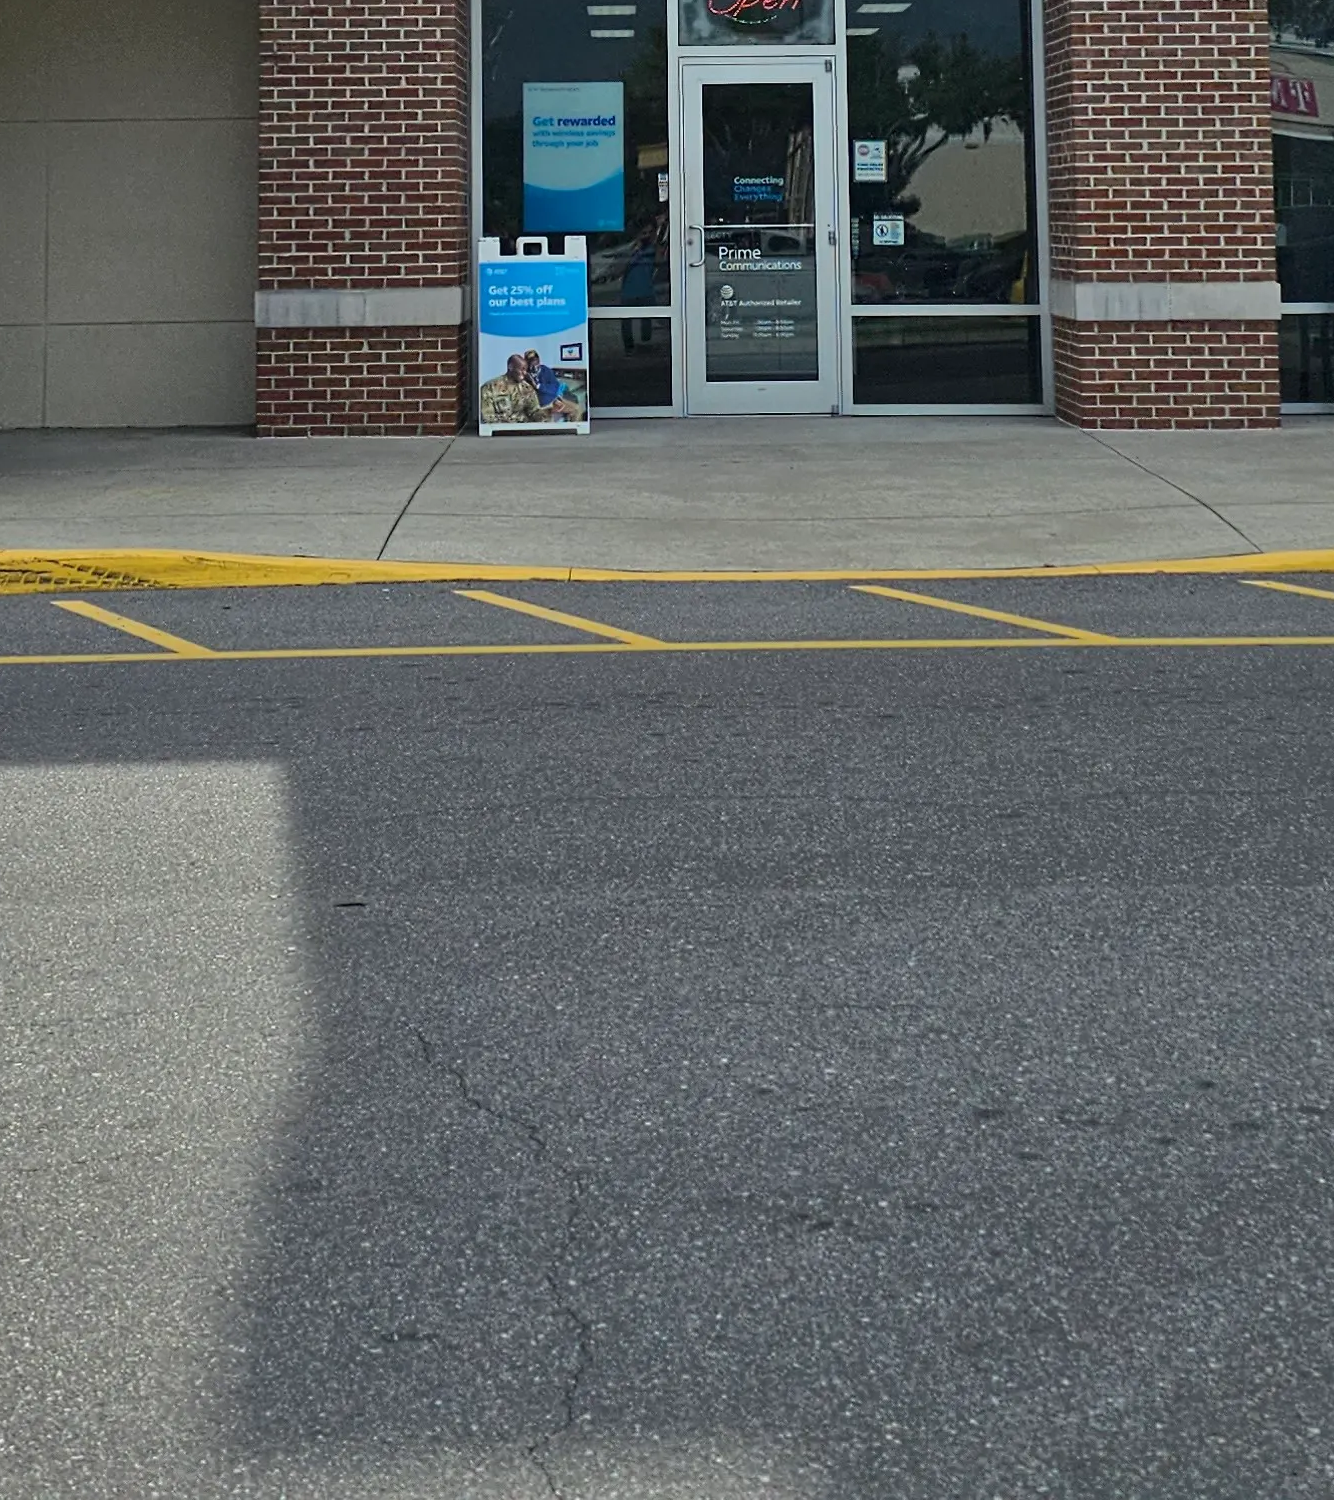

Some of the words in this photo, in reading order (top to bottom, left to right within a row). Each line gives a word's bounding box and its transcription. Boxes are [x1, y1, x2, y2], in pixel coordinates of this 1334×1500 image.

[532, 116, 555, 127] Get
[557, 115, 616, 127] rewarded
[733, 176, 784, 186] Connecting
[718, 246, 762, 260] Prime
[719, 260, 802, 271] Communications
[489, 285, 509, 295] Get
[510, 286, 534, 295] 25%
[535, 284, 554, 295] off
[489, 298, 507, 308] our
[509, 296, 534, 307] best
[536, 296, 567, 308] plans
